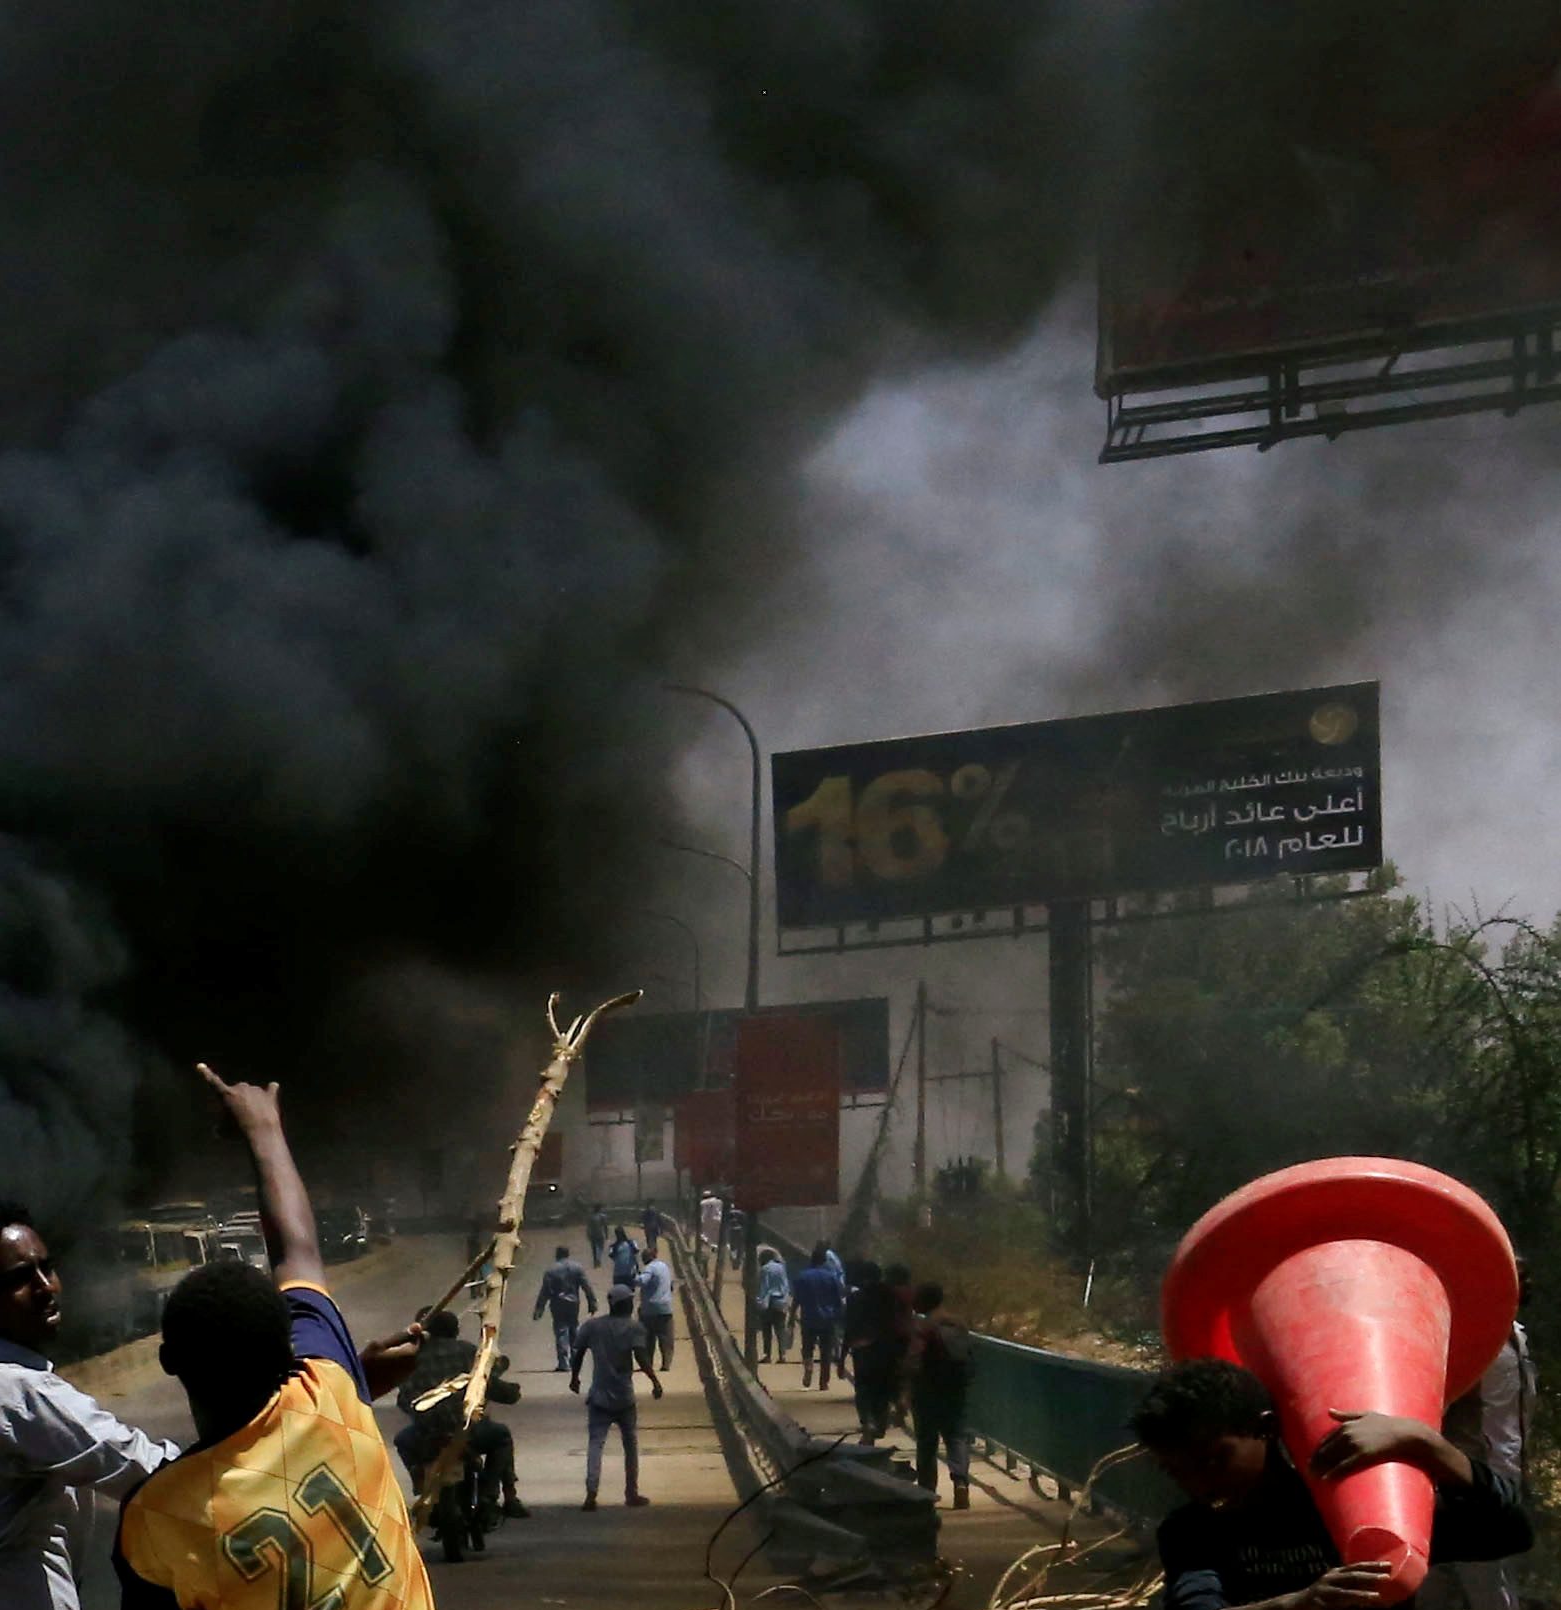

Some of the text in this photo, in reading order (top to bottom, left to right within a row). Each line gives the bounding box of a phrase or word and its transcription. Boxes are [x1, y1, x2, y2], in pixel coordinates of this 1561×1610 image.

[1275, 770, 1308, 785] بنك
[1224, 801, 1285, 825] عائد
[1293, 785, 1364, 822] أعلى
[1278, 825, 1364, 859] للعام
